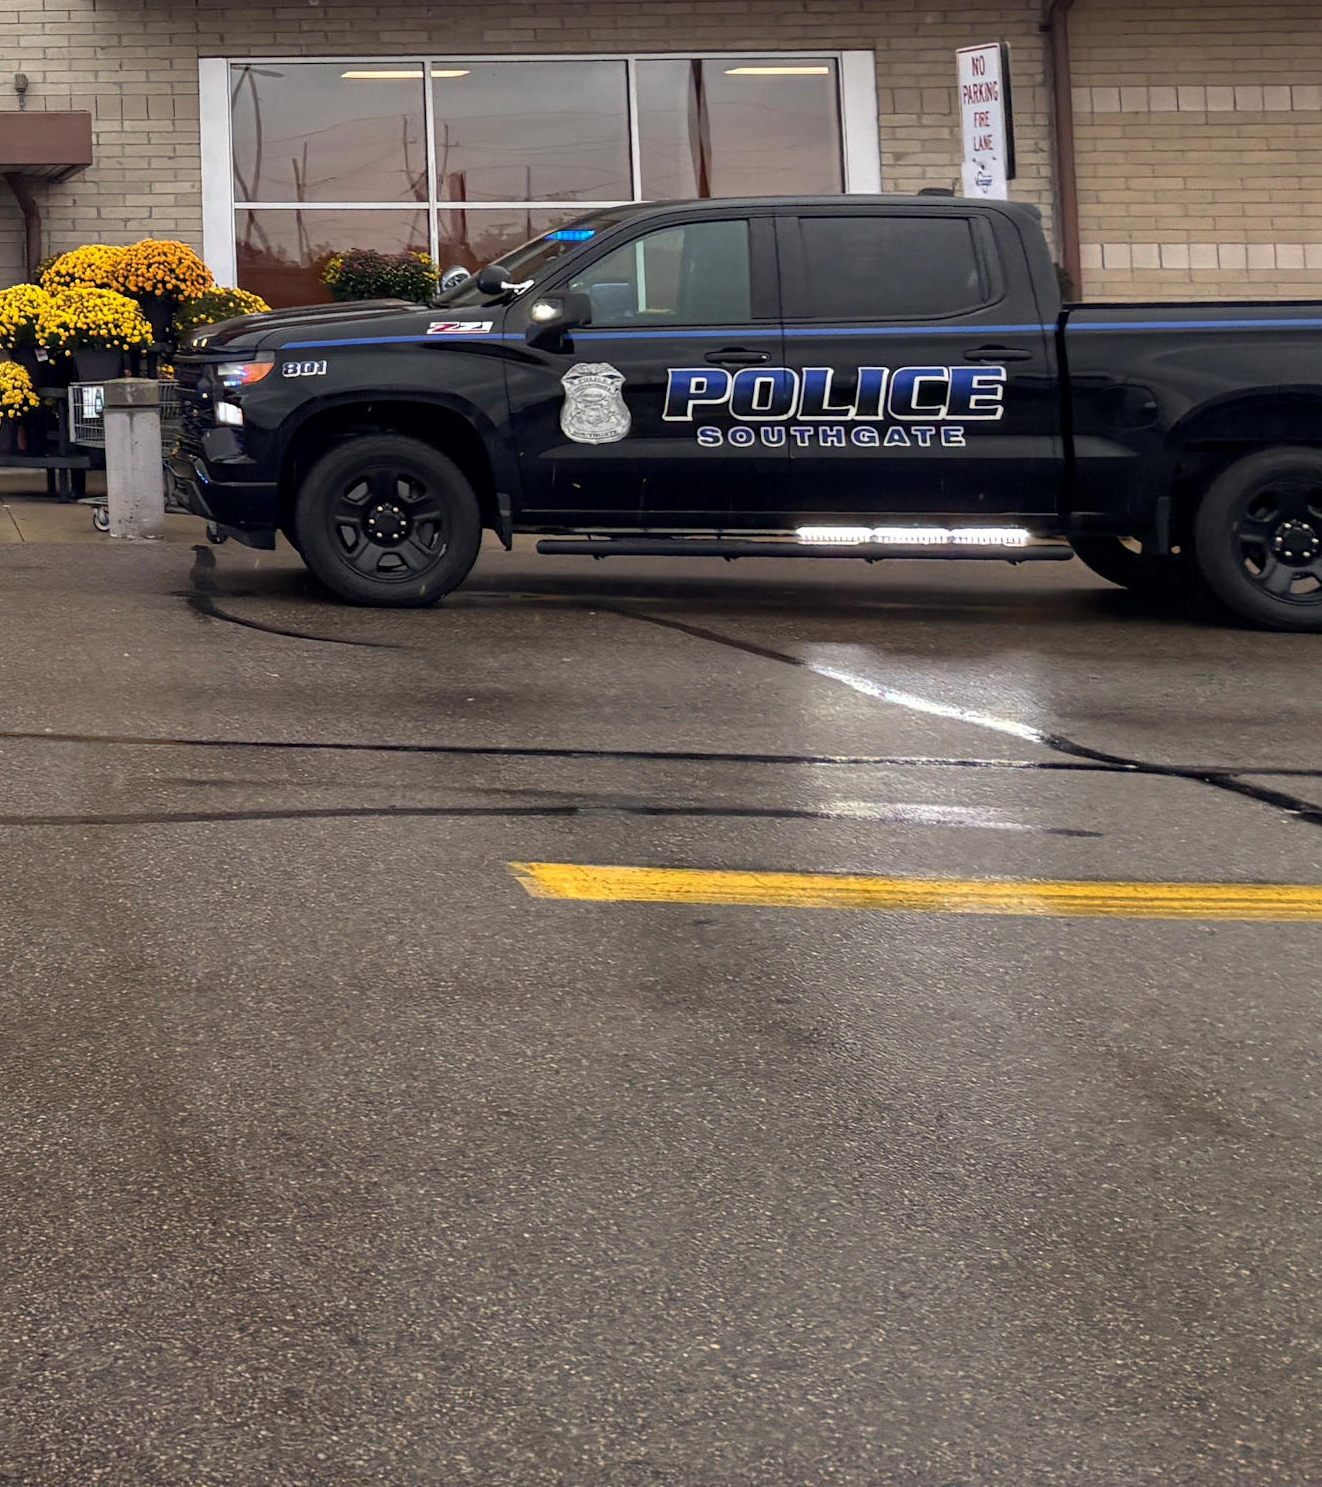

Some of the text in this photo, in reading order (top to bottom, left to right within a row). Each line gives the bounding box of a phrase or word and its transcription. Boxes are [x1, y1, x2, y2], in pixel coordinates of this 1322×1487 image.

[971, 55, 986, 77] NO
[963, 81, 998, 105] PARKING
[973, 111, 990, 128] FIRE
[973, 134, 994, 152] LANE
[282, 360, 327, 378] 801
[662, 366, 1007, 421] POLICE
[697, 426, 966, 447] SOUTHGATE
